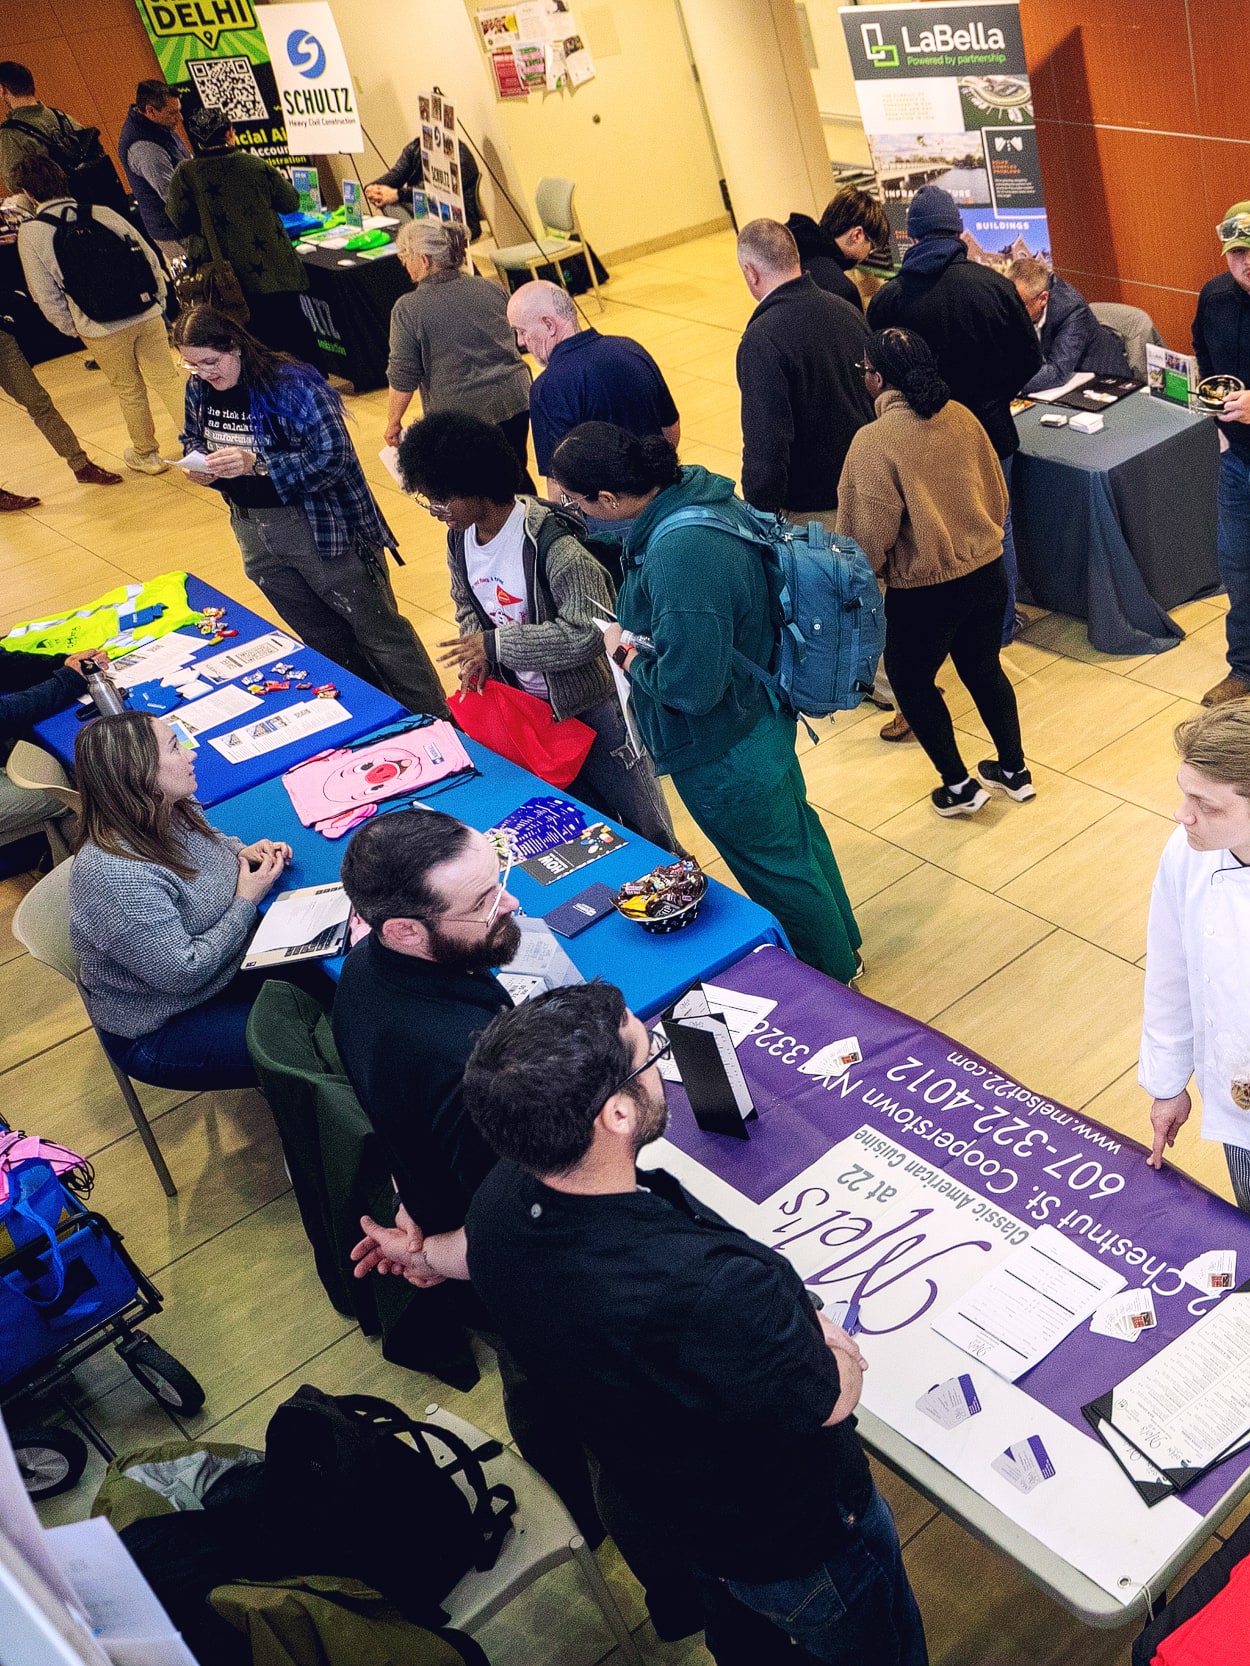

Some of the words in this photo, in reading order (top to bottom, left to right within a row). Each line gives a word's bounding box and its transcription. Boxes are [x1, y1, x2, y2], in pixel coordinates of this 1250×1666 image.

[152, 0, 249, 30] DELHI
[901, 21, 1006, 53] LaBella
[907, 55, 944, 66] Powered
[945, 54, 957, 66] by
[957, 51, 1006, 65] partnership
[283, 87, 354, 116] SCHULTZ
[235, 129, 268, 146] ncial
[271, 126, 288, 142] Ai
[288, 118, 308, 128] Heavy
[308, 118, 321, 126] Civil
[321, 116, 357, 126] Construction
[976, 221, 1030, 231] BUILDINGS
[946, 1051, 1122, 1155] www.melsat22.com
[861, 1087, 1019, 1194] Cooperstown
[886, 1055, 1126, 1200] 607-322-4012
[854, 1129, 907, 1167] Cuisine
[837, 1163, 876, 1192] 22
[863, 1180, 898, 1204] at
[904, 1158, 976, 1211] American
[1026, 1186, 1061, 1221] St.
[971, 1201, 1030, 1246] Classic
[770, 1186, 992, 1336] Mel's
[1060, 1209, 1186, 1297] Chestnut
